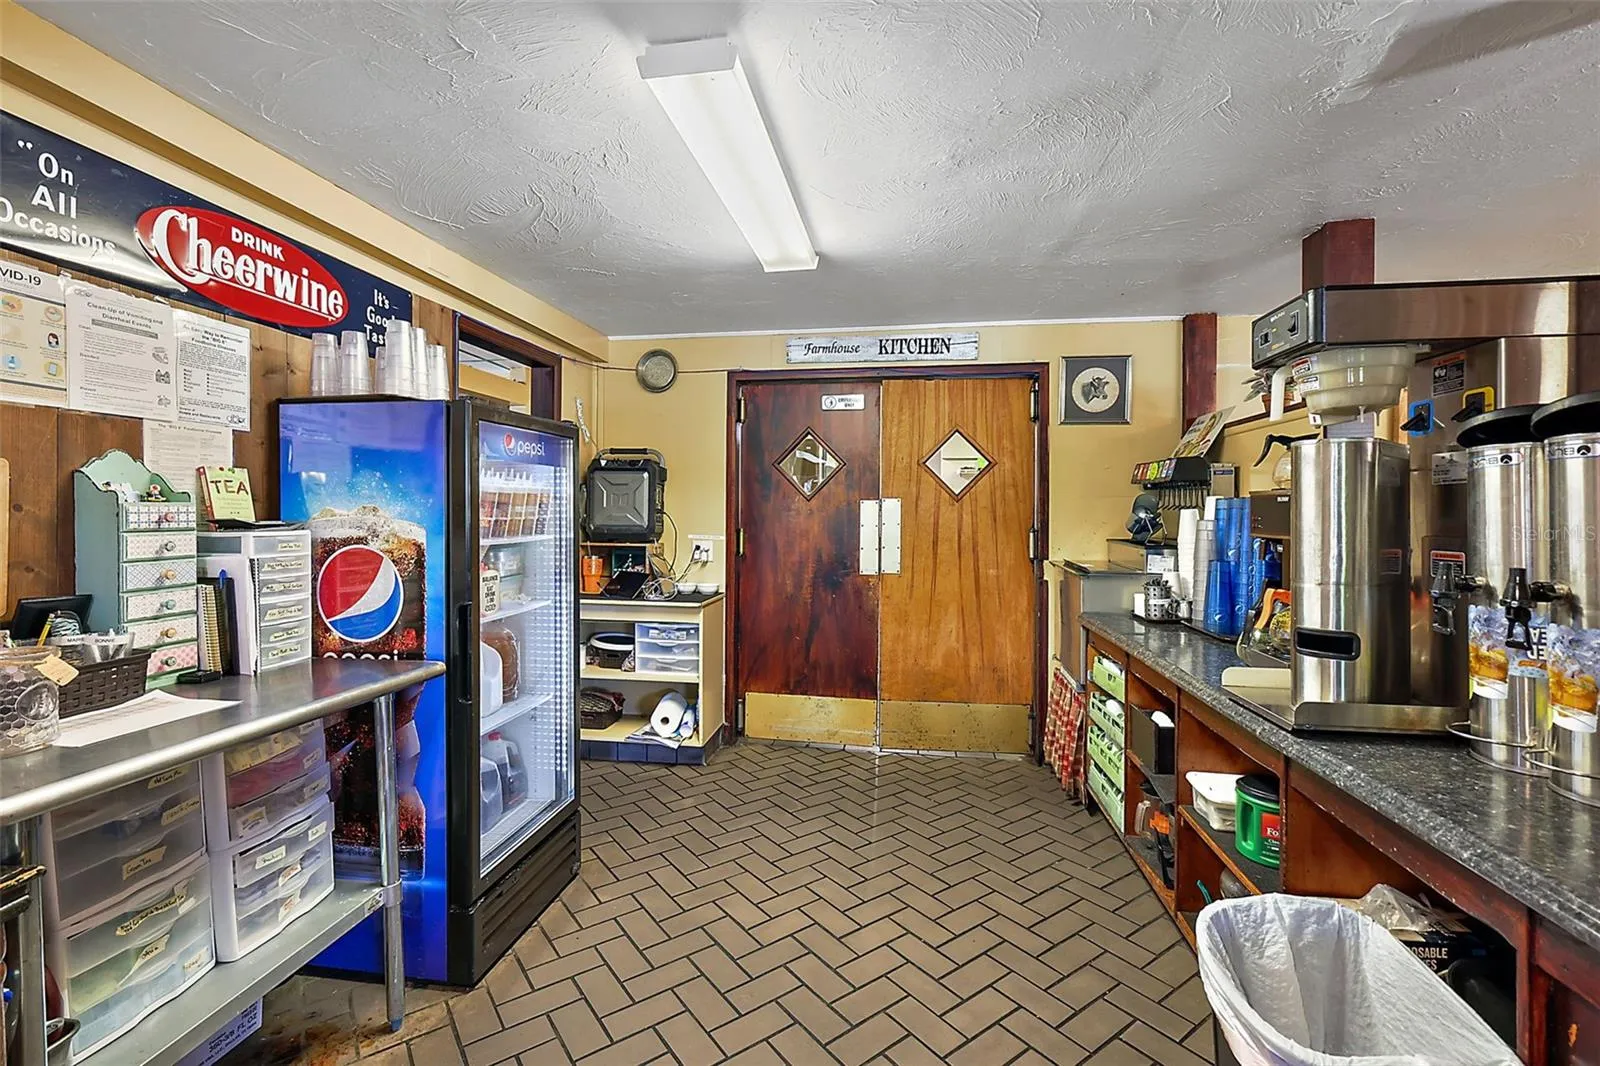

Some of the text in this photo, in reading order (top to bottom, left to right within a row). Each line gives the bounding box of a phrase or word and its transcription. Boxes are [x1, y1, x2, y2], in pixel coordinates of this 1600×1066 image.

[31, 184, 77, 219] All
[0, 196, 117, 255] Occasions
[231, 226, 285, 262] DRINK
[133, 208, 345, 319] Cheerwine
[374, 288, 390, 310] It's
[366, 307, 396, 328] Goo
[803, 337, 952, 356] Farmhouse KITCHEN
[517, 439, 545, 458] pepsi
[210, 480, 249, 496] TEA
[1529, 627, 1547, 643] EA
[1411, 946, 1448, 959] OSABLE
